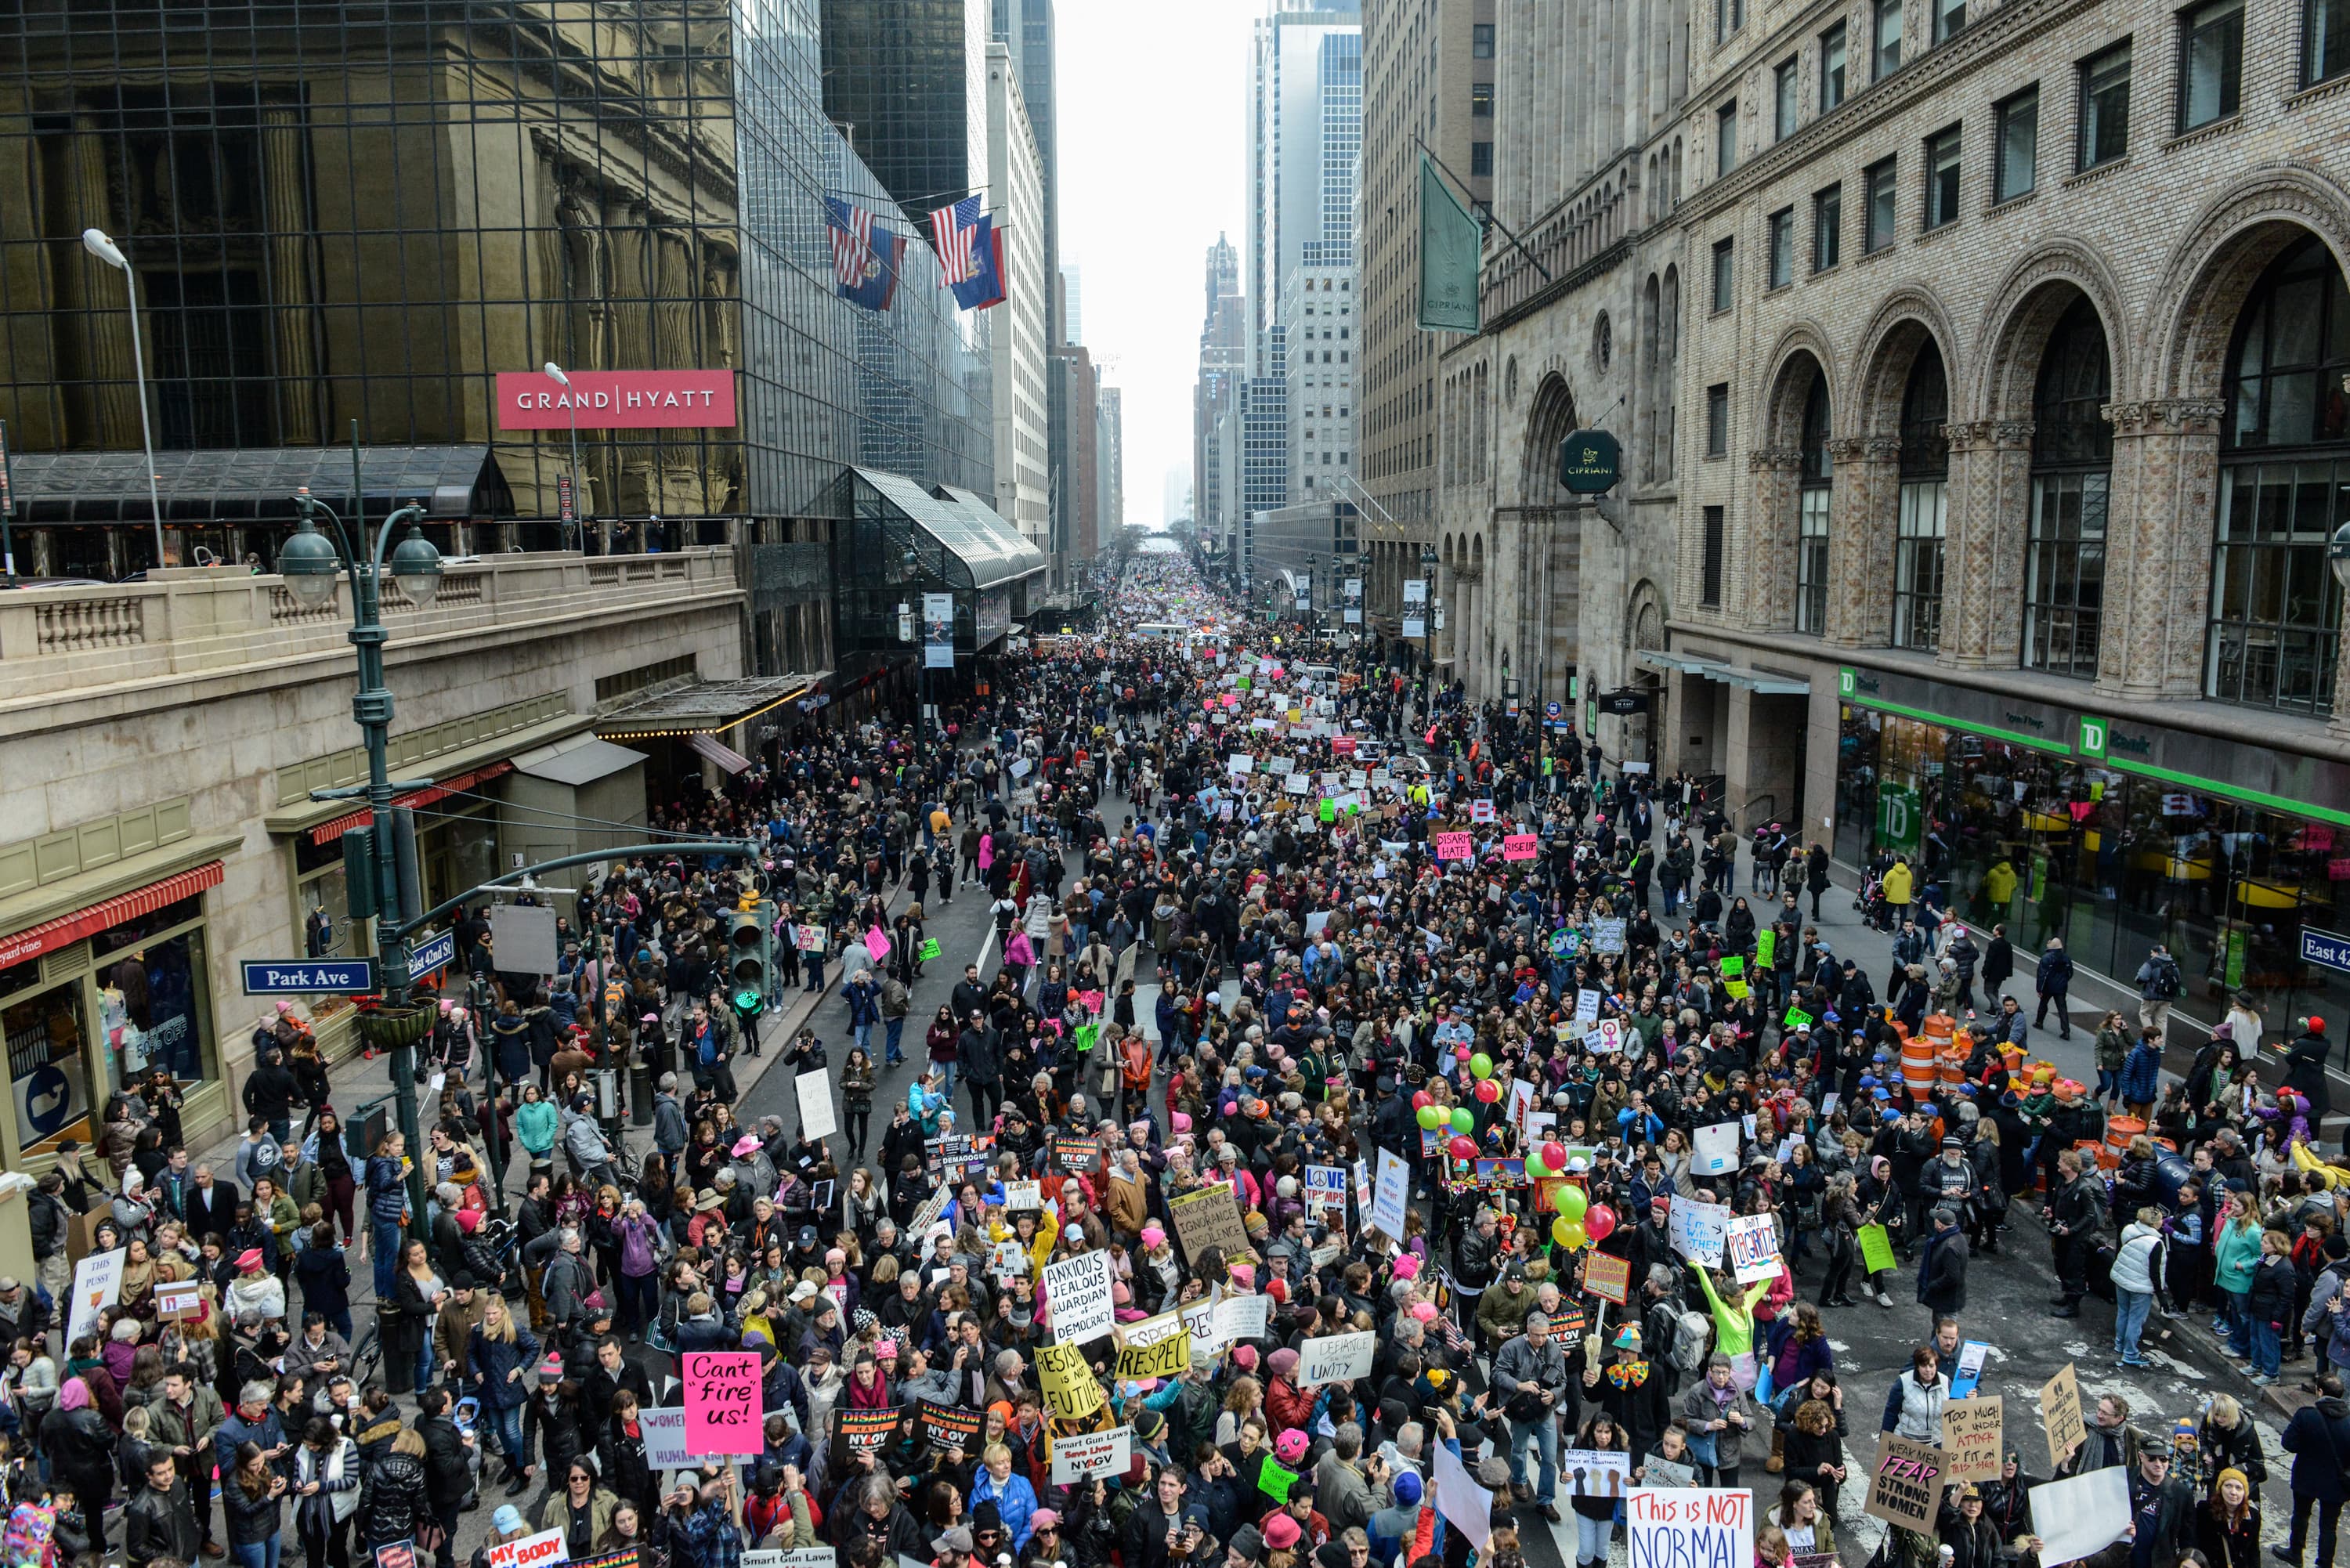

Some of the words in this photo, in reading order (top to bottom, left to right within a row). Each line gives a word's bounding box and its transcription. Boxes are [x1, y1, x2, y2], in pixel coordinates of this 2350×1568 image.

[1427, 299, 1474, 312] CIPRIANI
[517, 392, 609, 410] GRAND
[627, 390, 714, 407] HYATT
[1568, 465, 1612, 475] CIPRIANI
[1842, 671, 1853, 693] TD
[2083, 724, 2102, 750] TD
[2110, 729, 2150, 755] Bank
[1882, 794, 1907, 840] TD
[1438, 833, 1471, 846] DISARM
[1505, 841, 1522, 853] RISE
[1523, 841, 1536, 852] UP
[1442, 846, 1466, 858] HATE
[20, 939, 42, 955] vines
[2305, 938, 2335, 961] East
[408, 956, 425, 976] East
[425, 945, 442, 966] 42nd
[442, 940, 452, 956] St
[266, 970, 310, 986] Park
[314, 969, 349, 985] Ave
[137, 1037, 162, 1059] 50%
[163, 1021, 188, 1046] OFF
[924, 1135, 962, 1147] MISOGYNIST
[1056, 1137, 1097, 1148] DISARM
[942, 1152, 989, 1165] DEMAGOGUE
[1061, 1153, 1090, 1163] NYAGV
[1173, 1191, 1231, 1219] ARROGANCE
[1179, 1208, 1236, 1234] IGNORANCE
[1726, 1220, 1735, 1234] I
[1744, 1216, 1760, 1230] Don't
[1185, 1224, 1242, 1251] INSOLENCE
[1687, 1228, 1709, 1239] With
[1690, 1238, 1723, 1252] THEM
[1729, 1224, 1778, 1265] PLAGIARIZE
[92, 1258, 110, 1272] THIS
[1047, 1253, 1103, 1285] ANXIOUS
[1589, 1259, 1618, 1274] CIRCUS
[85, 1272, 110, 1288] PUSSY
[1053, 1272, 1105, 1299] JEALOUS
[1589, 1270, 1626, 1284] HORRORS
[1052, 1286, 1107, 1315] GUARDIAN
[78, 1318, 98, 1333] GRA
[1058, 1310, 1111, 1339] DEMOCRACY
[1549, 1309, 1584, 1325] SARM
[1118, 1330, 1191, 1377] RESPECT
[1319, 1337, 1369, 1357] DEFIANCE
[692, 1356, 754, 1378] Can't
[1061, 1375, 1070, 1385] IS
[1074, 1365, 1086, 1382] NOT
[1311, 1362, 1354, 1380] UNITY
[2053, 1381, 2064, 1400] 99
[2048, 1389, 2074, 1418] PROBLEMS
[707, 1404, 750, 1425] us!
[841, 1409, 900, 1423] DISARM
[923, 1402, 982, 1424] DISARM
[1944, 1409, 1968, 1424] TOO
[1974, 1405, 1999, 1419] MUCH
[935, 1418, 961, 1429] HATE
[1953, 1425, 1962, 1435] IS
[1972, 1420, 2001, 1431] UNDER
[848, 1431, 888, 1446] NYAGV
[927, 1424, 968, 1443] NYAGV
[1054, 1438, 1083, 1450] Smart
[1086, 1434, 1104, 1446] Gun
[1107, 1429, 1129, 1441] Laws
[1957, 1431, 1995, 1447] ATTACK
[1065, 1451, 1087, 1459] Save
[1090, 1443, 1113, 1454] Lives
[1888, 1440, 1916, 1458] WEAK
[1917, 1450, 1940, 1465] MEN
[1964, 1451, 1979, 1462] FIT
[1983, 1449, 1995, 1459] ON
[1071, 1454, 1113, 1471] NYAGV
[1653, 1458, 1665, 1468] BE
[1950, 1463, 1971, 1474] THIS
[1976, 1461, 1994, 1470] SIGN
[1880, 1456, 1940, 1489] FEAR
[1878, 1476, 1931, 1505] STRONG
[1630, 1492, 1677, 1523] This
[1686, 1501, 1701, 1523] is
[1707, 1493, 1750, 1530] NOT
[1876, 1490, 1928, 1521] WOMEN
[490, 1543, 516, 1565] MY
[515, 1537, 562, 1564] BODY
[743, 1556, 776, 1566] Smart
[780, 1554, 802, 1563] Gun
[805, 1552, 833, 1562] Laws
